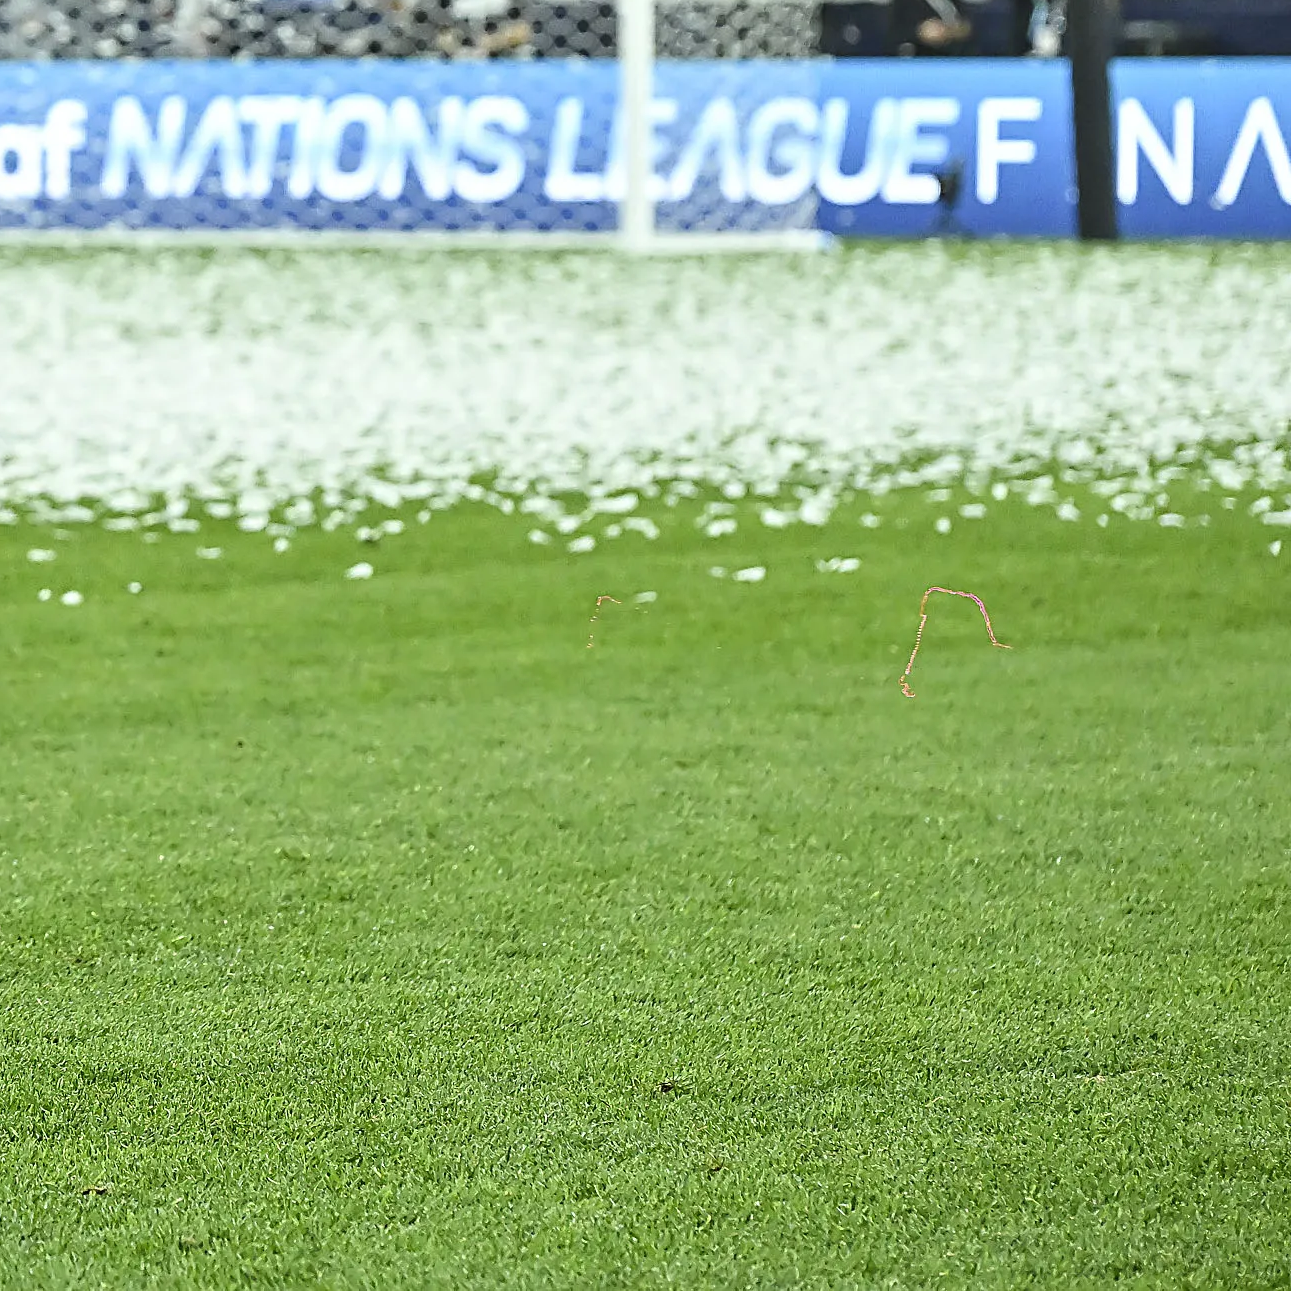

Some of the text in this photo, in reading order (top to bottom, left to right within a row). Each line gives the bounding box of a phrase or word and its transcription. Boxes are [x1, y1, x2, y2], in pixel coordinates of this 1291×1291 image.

[101, 94, 529, 203] NATIONS
[543, 96, 961, 206] LEAGUE
[976, 96, 1291, 206] FNA
